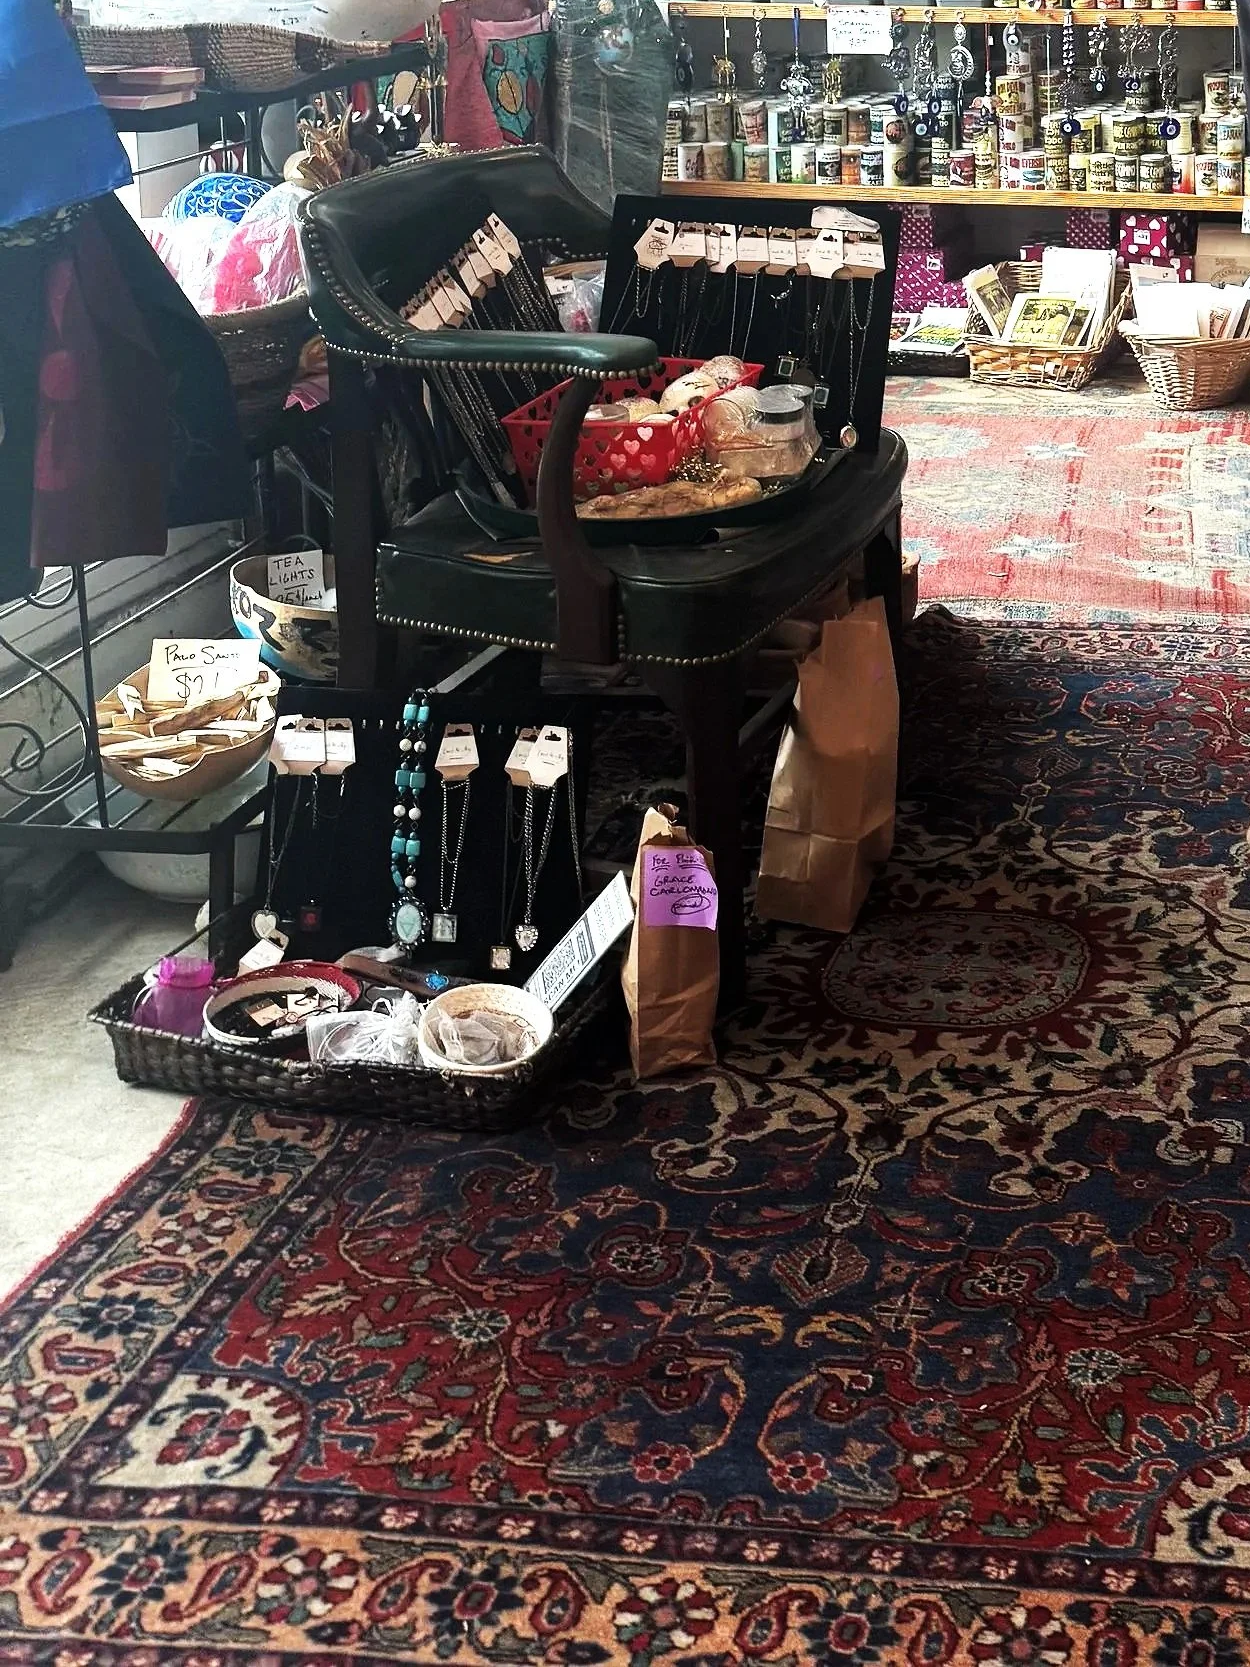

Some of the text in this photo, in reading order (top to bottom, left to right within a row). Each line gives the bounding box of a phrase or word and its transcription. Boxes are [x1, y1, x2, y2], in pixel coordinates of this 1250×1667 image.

[273, 556, 304, 570] TEA
[269, 569, 315, 586] LIGHTS
[654, 875, 696, 887] GRACE
